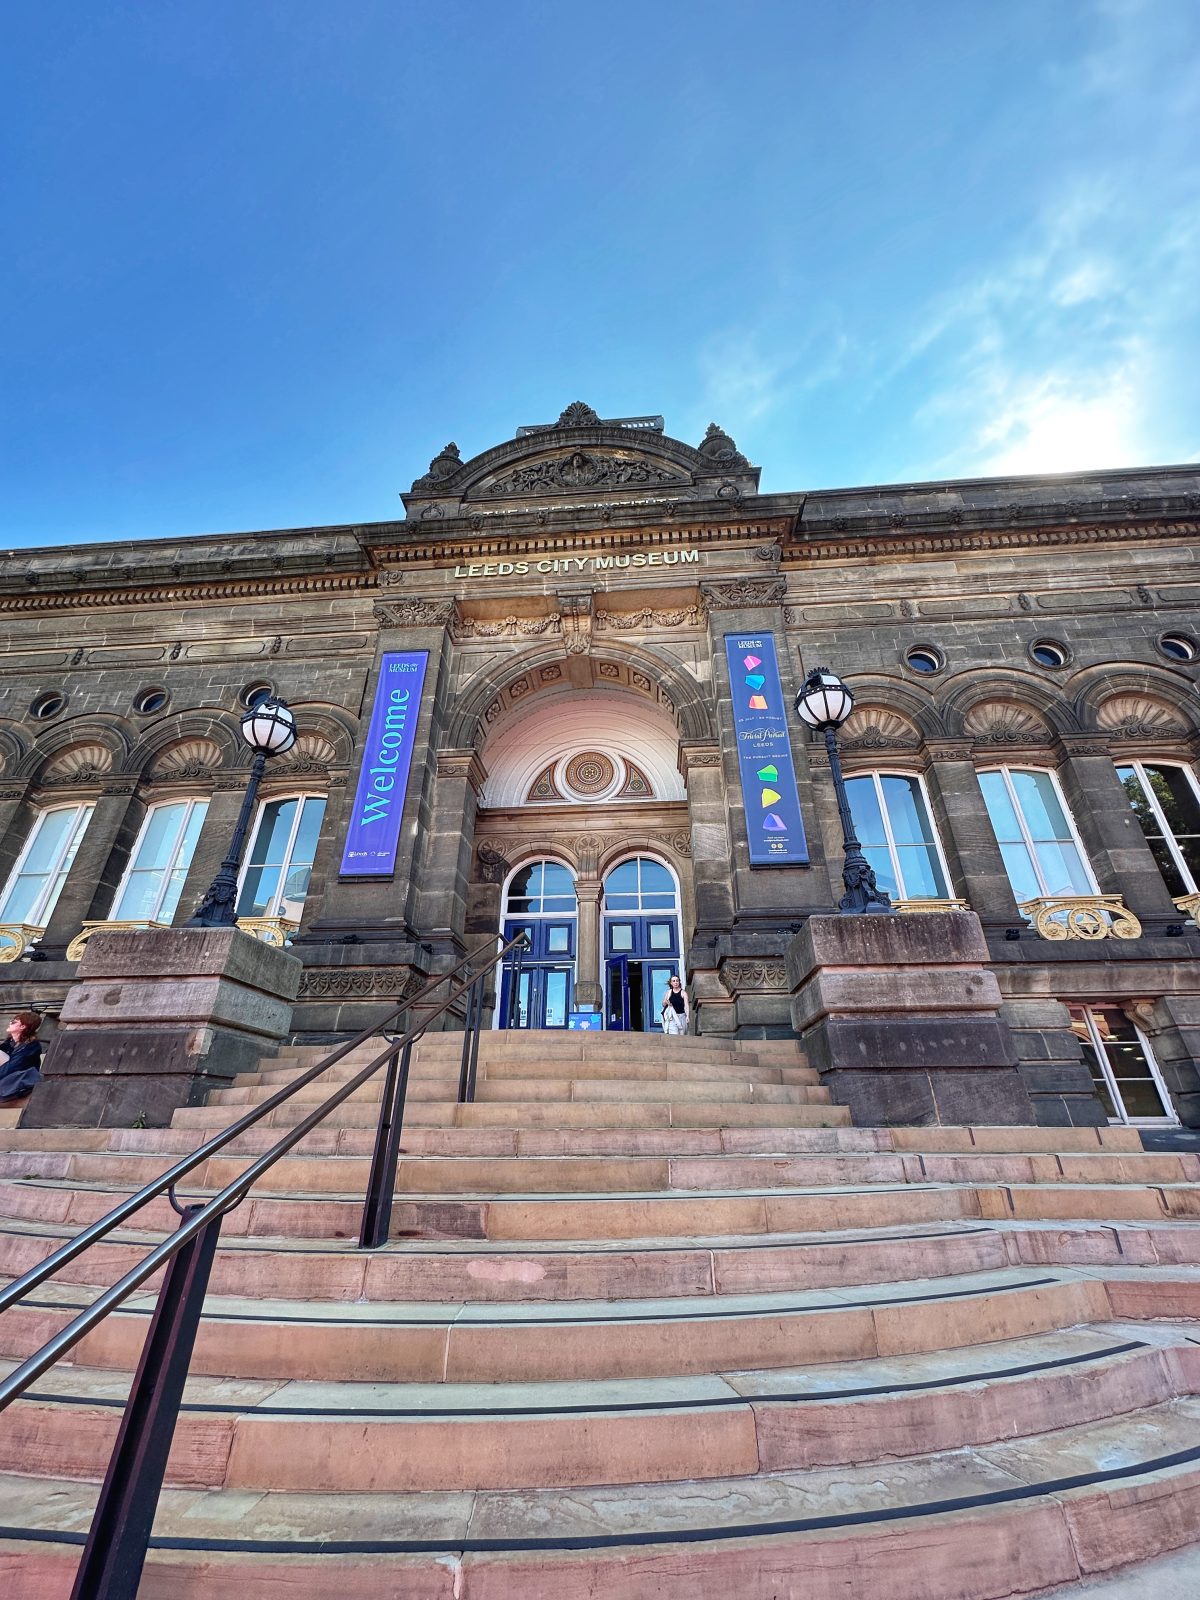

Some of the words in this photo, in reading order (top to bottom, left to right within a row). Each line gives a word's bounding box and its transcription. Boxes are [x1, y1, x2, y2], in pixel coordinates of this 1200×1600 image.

[454, 562, 528, 578] LEEDS
[537, 557, 590, 573] CITY
[596, 550, 699, 569] MUSEUM
[360, 688, 410, 826] Welcome
